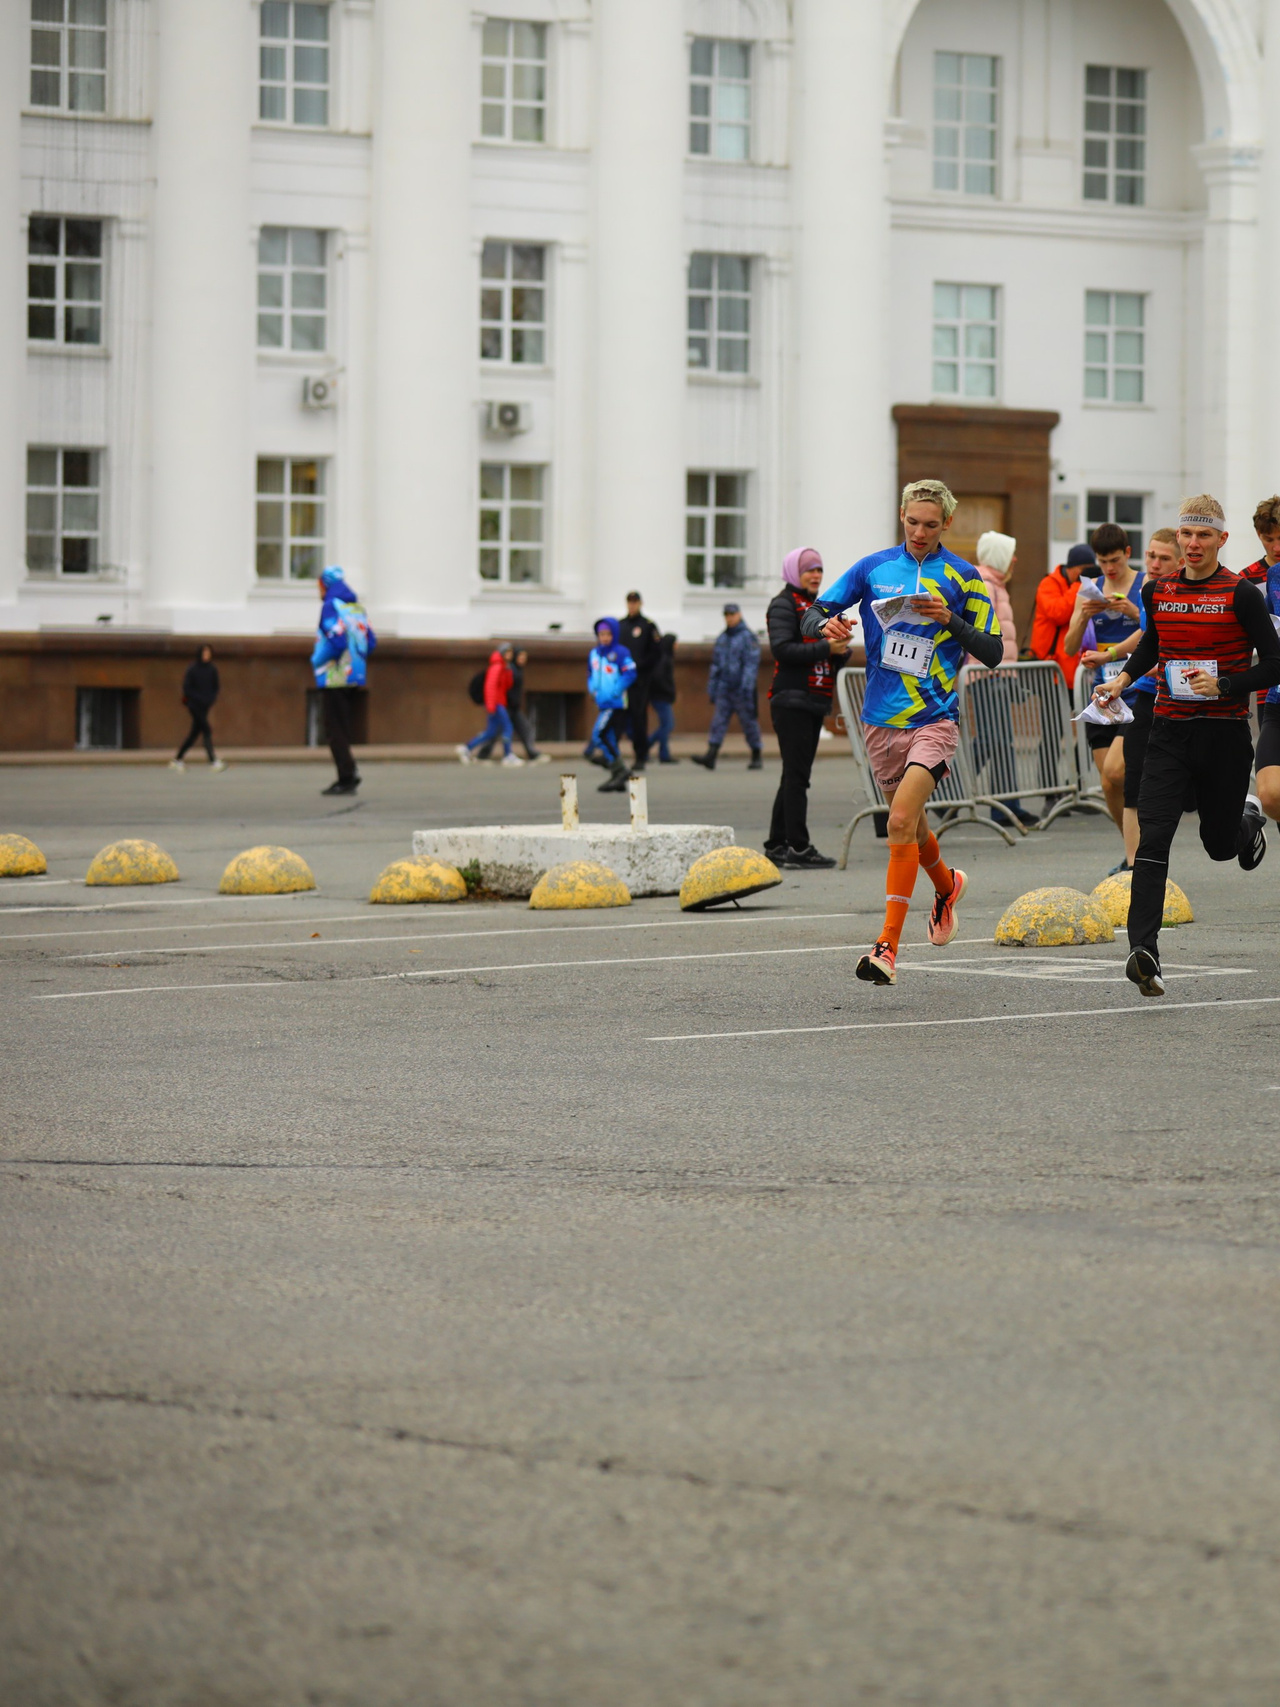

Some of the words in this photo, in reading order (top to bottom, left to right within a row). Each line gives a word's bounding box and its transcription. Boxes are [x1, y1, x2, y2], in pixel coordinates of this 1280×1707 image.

[1158, 601, 1189, 613] NORD
[1191, 603, 1227, 614] WEST
[891, 642, 917, 660] 11.1
